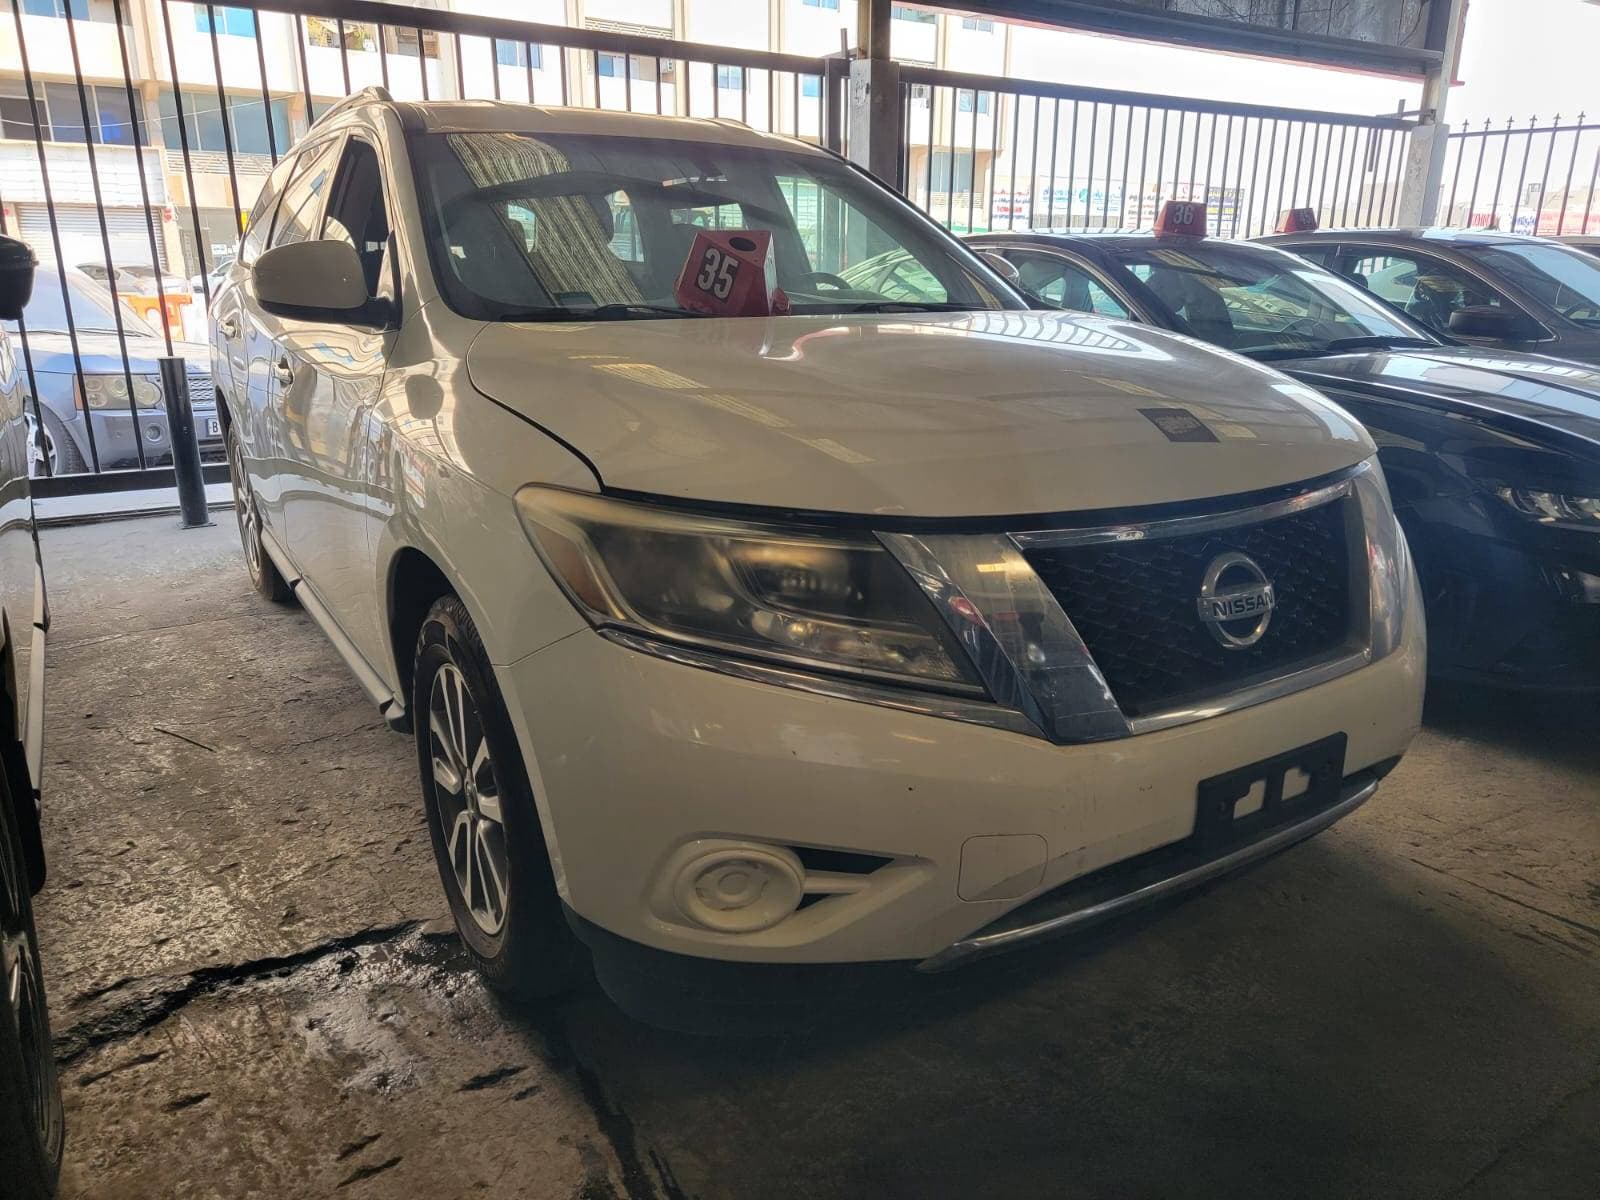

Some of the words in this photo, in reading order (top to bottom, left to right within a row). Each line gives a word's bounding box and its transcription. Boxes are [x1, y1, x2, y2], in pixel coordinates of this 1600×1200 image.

[1173, 204, 1194, 225] 36
[697, 248, 739, 299] 35
[1212, 591, 1273, 617] NISSAN
